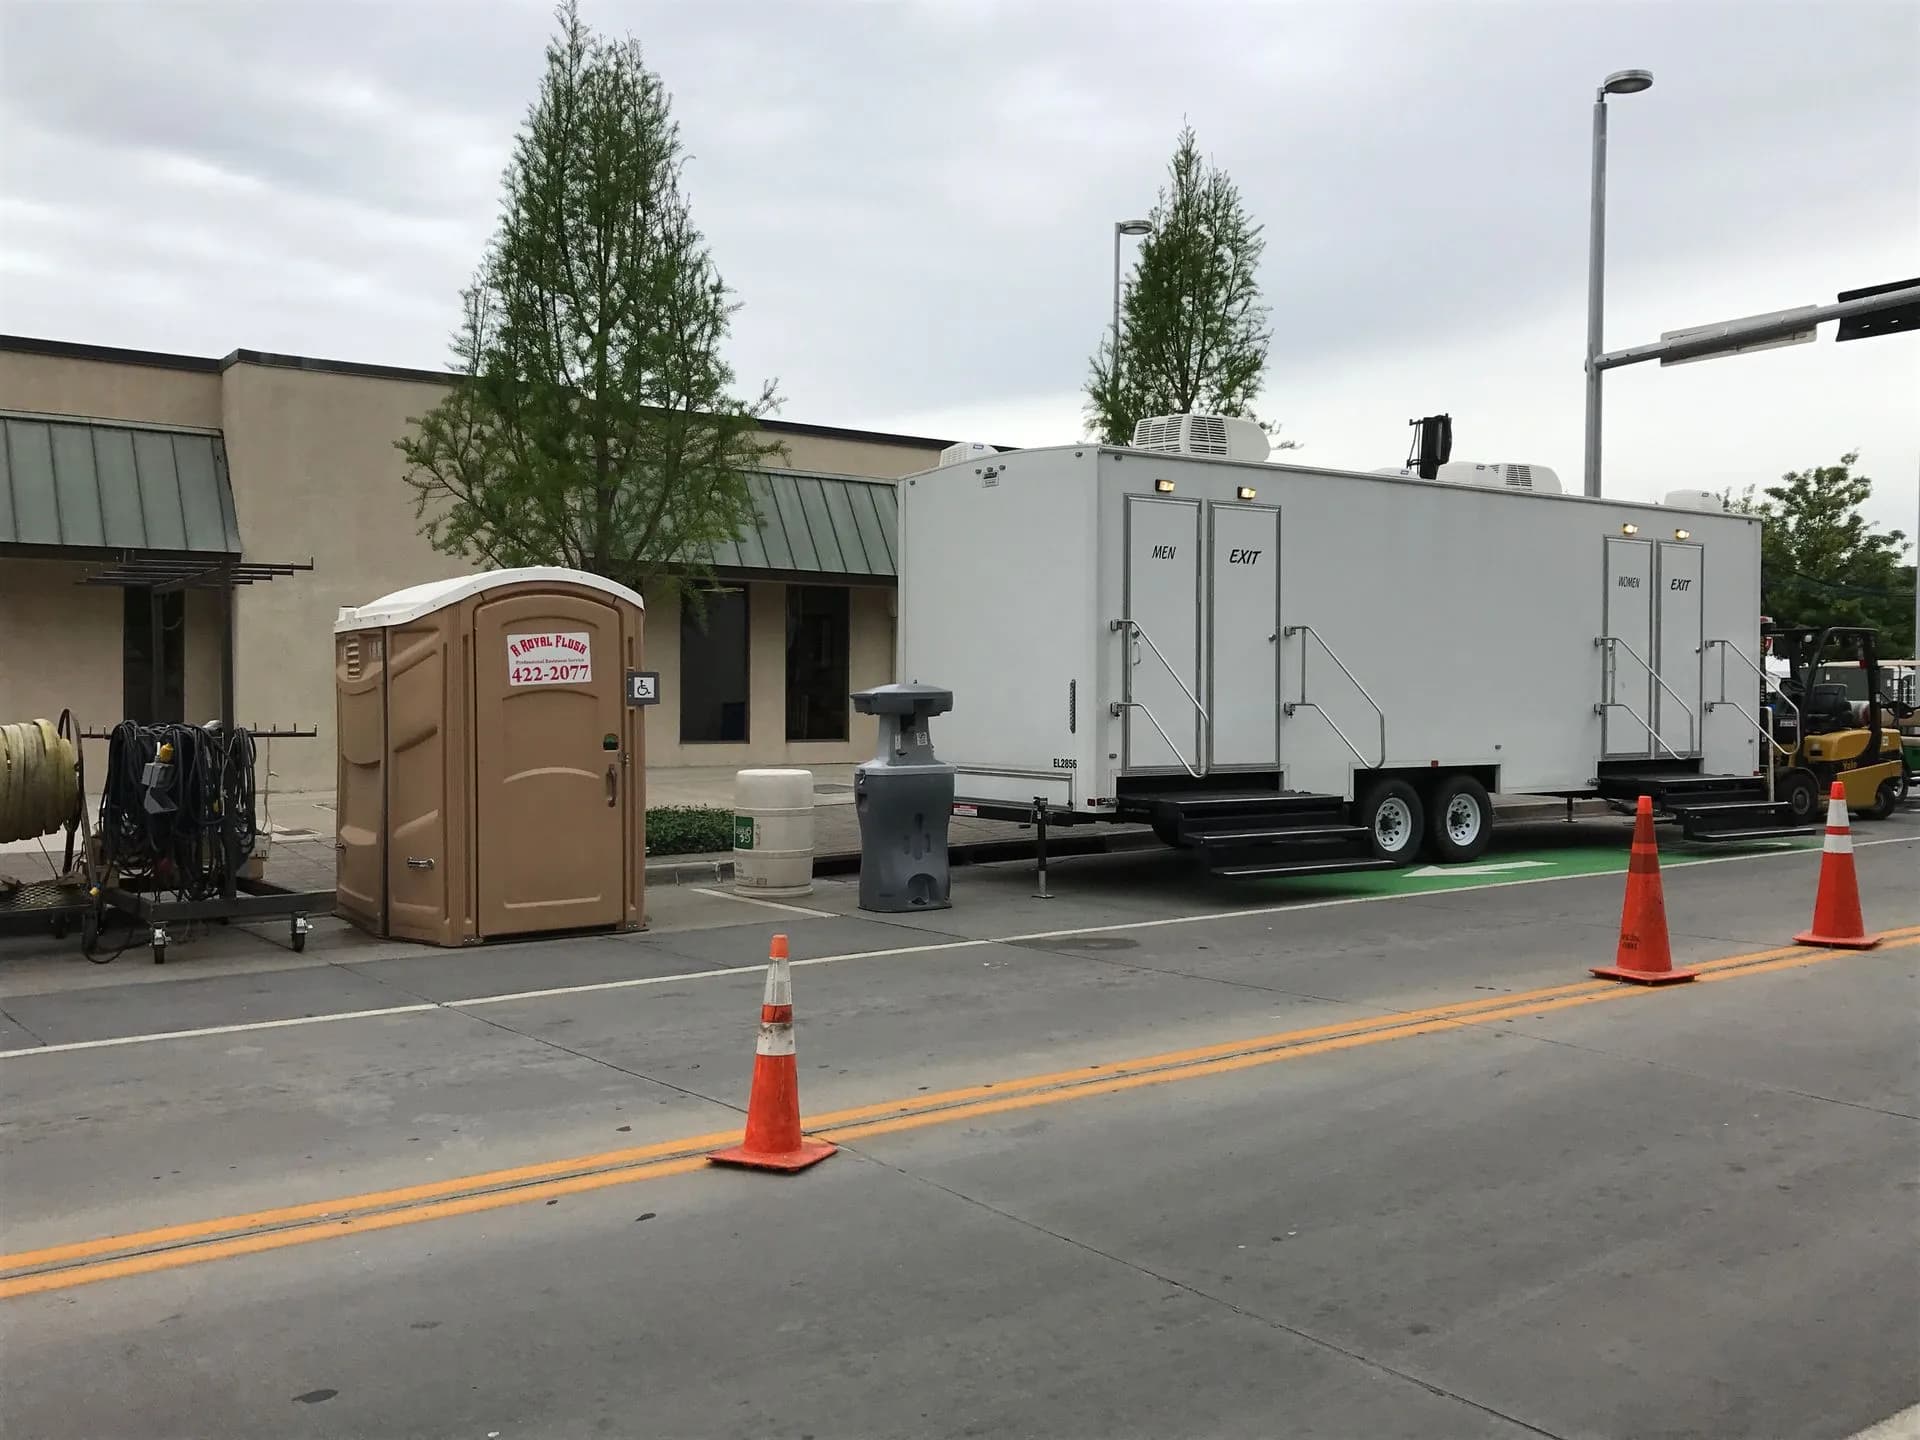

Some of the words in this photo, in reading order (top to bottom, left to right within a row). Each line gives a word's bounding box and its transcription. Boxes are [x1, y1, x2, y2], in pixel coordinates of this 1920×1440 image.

[1152, 545, 1176, 560] MEN
[1229, 549, 1262, 565] EXIT
[1618, 576, 1640, 588] WOMEN
[1670, 578, 1691, 591] EXIT
[510, 644, 521, 657] A
[519, 636, 552, 653] ROYAL
[512, 665, 588, 682] 422-2077
[1053, 758, 1077, 769] EL2856
